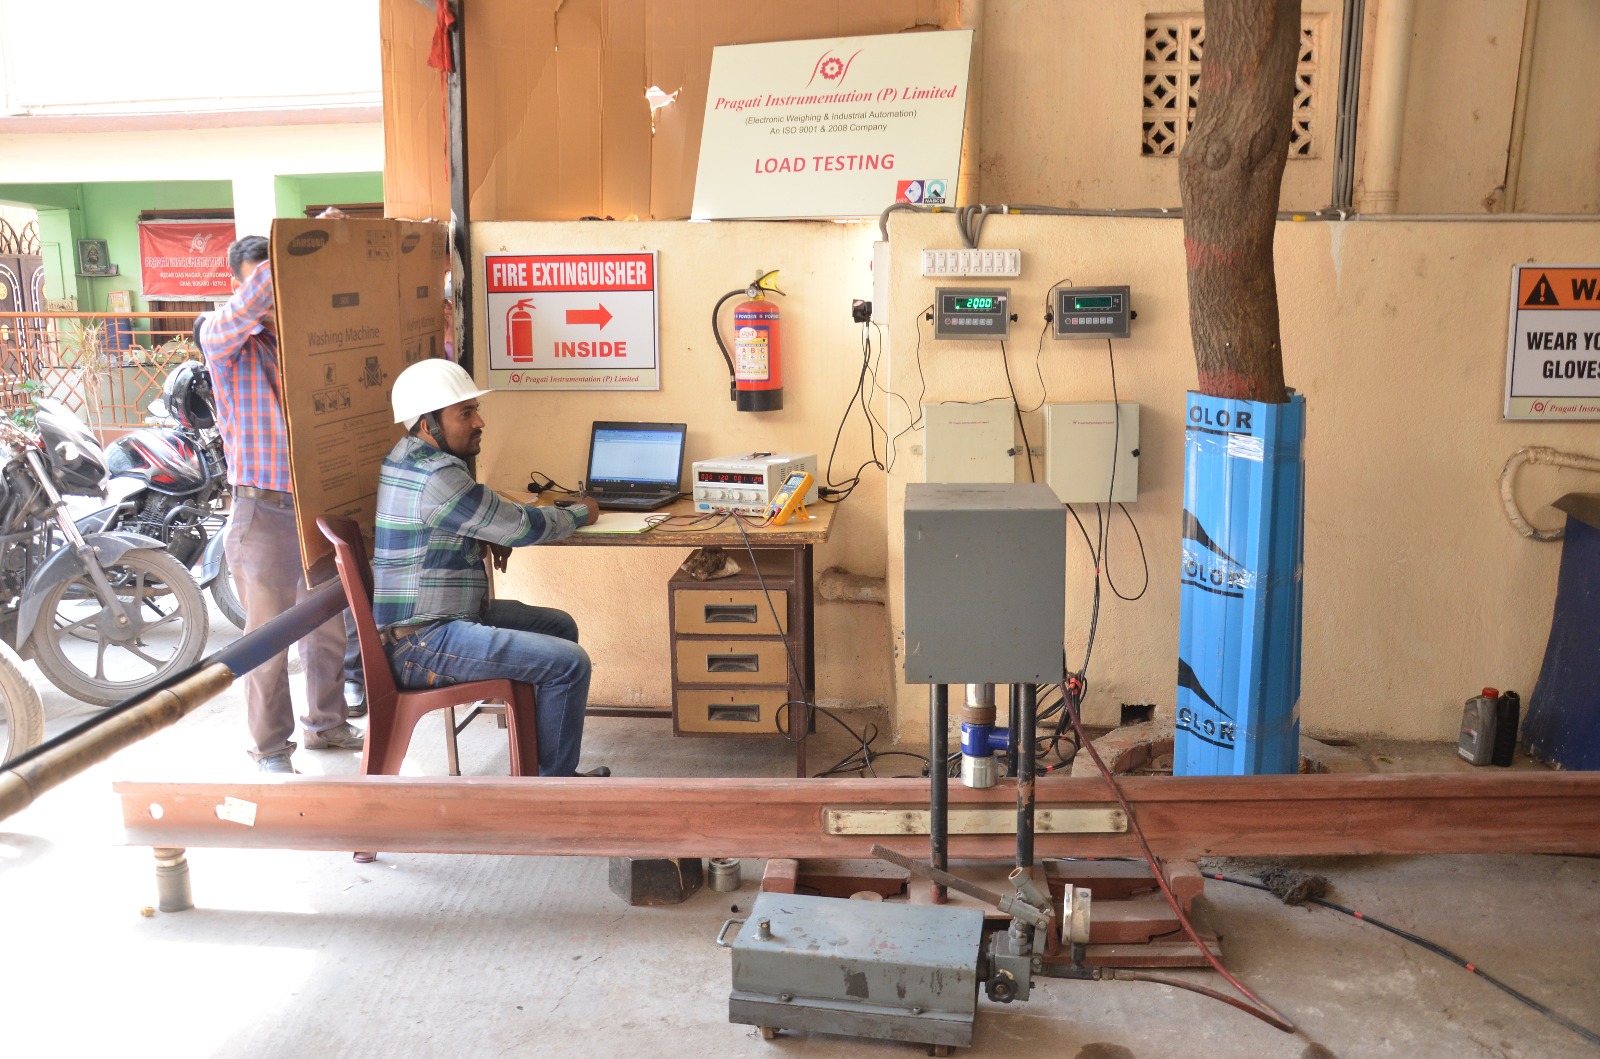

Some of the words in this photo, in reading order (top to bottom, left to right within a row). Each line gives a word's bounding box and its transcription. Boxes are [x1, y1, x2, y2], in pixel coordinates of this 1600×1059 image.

[714, 94, 763, 111] Pragati
[765, 90, 873, 107] Instrumentation
[876, 88, 898, 103] (P)
[902, 85, 957, 100] Limited
[745, 115, 784, 125] (Electronic
[786, 112, 822, 123] Weighing
[823, 112, 829, 120] &
[832, 111, 867, 120] Industrial
[869, 109, 917, 119] Automation)
[769, 127, 780, 135] An
[782, 126, 797, 134] ISO
[799, 125, 818, 134] 9001
[828, 124, 848, 133] 2008
[850, 123, 887, 132] Company
[755, 157, 806, 173] LOAD
[812, 153, 895, 171] TESTING
[493, 262, 527, 287] FIRE
[532, 261, 647, 286] EXTINGUISHER
[1571, 278, 1600, 301] W
[966, 298, 992, 308] 2000
[308, 331, 343, 347] Washing
[345, 326, 380, 341] Machine
[1526, 332, 1578, 351] WEAR
[554, 341, 627, 358] INSIDE
[525, 375, 549, 384] Pragati
[550, 375, 601, 383] Instrumentation
[602, 375, 613, 383] (P)
[1549, 404, 1578, 414] Pragati
